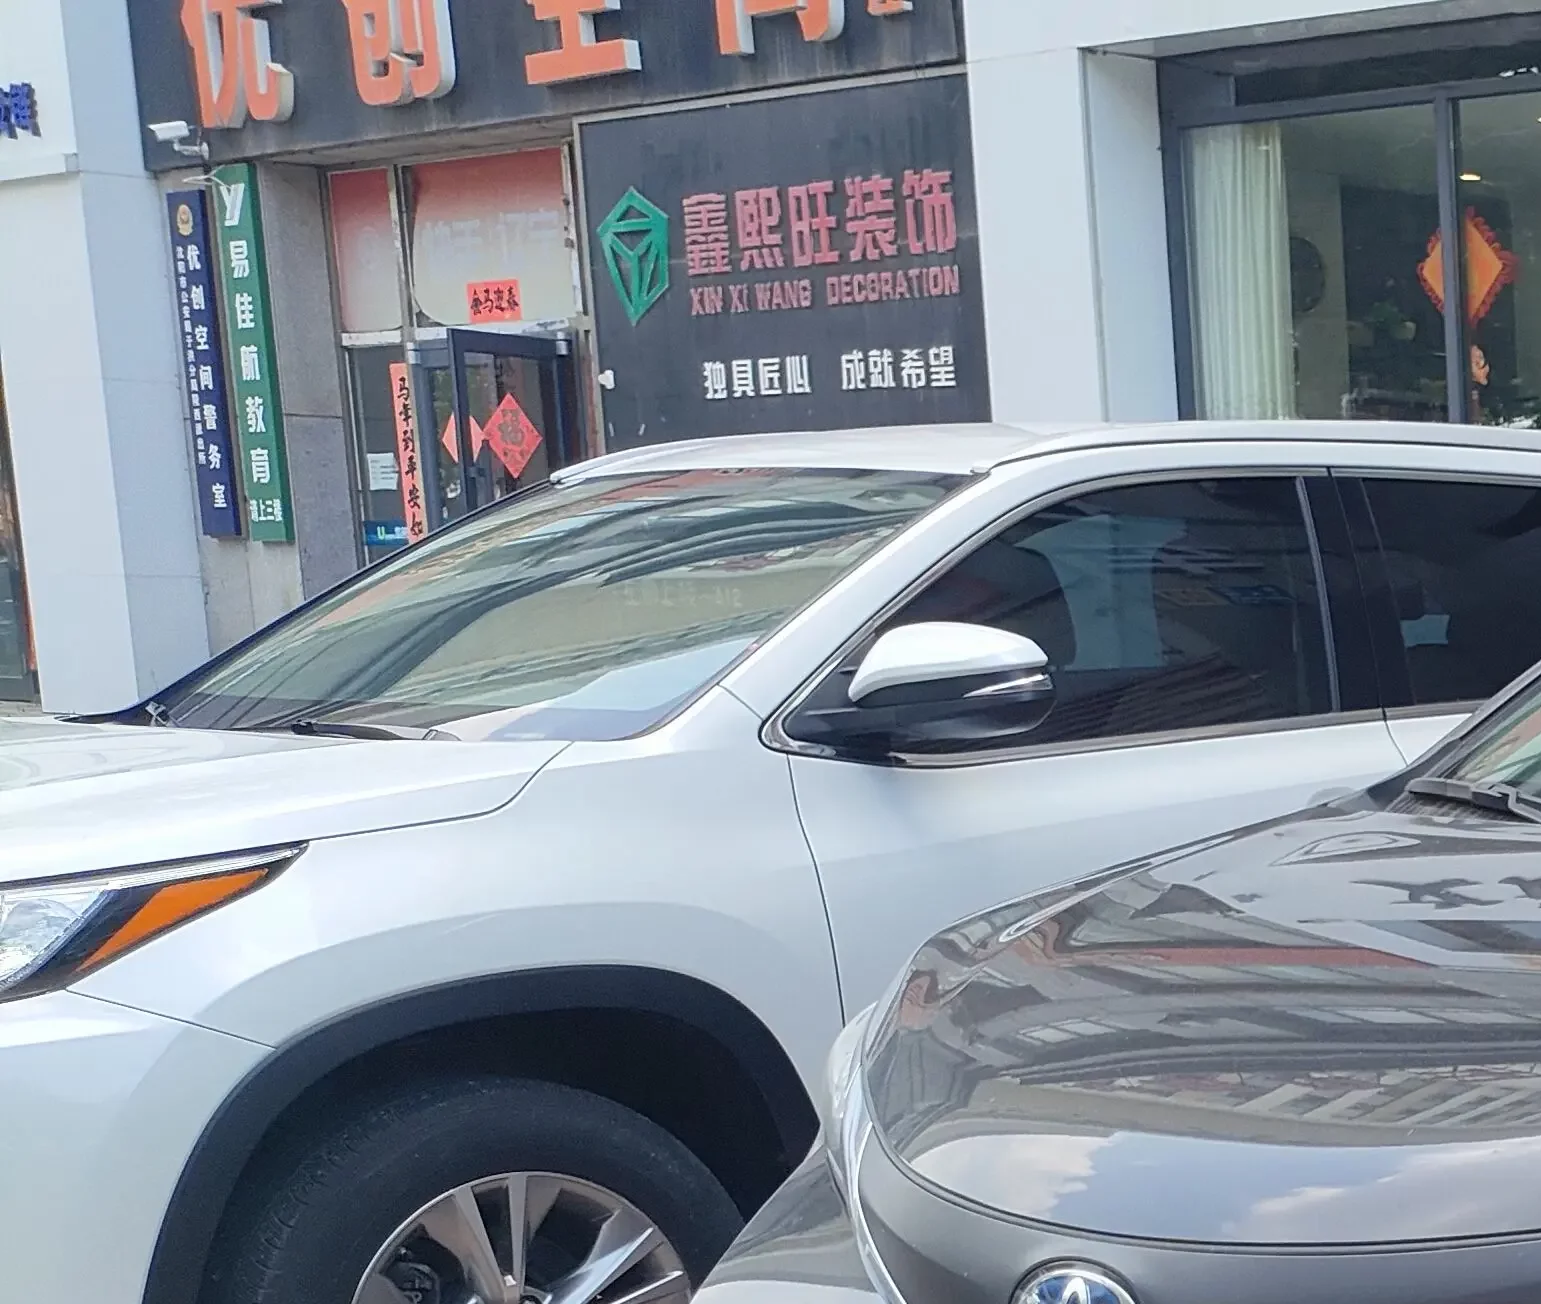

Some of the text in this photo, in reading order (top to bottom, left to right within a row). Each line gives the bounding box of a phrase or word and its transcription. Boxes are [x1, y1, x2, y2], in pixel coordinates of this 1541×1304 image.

[682, 169, 957, 276] 鑫熙旺装饰
[690, 285, 723, 316] XIN
[754, 279, 812, 311] WANG
[826, 265, 961, 306] DECORATION
[187, 244, 228, 508] 优创空间警务室
[229, 240, 271, 484] 易佳航教育
[703, 346, 957, 400] 独具匠心 成就希望
